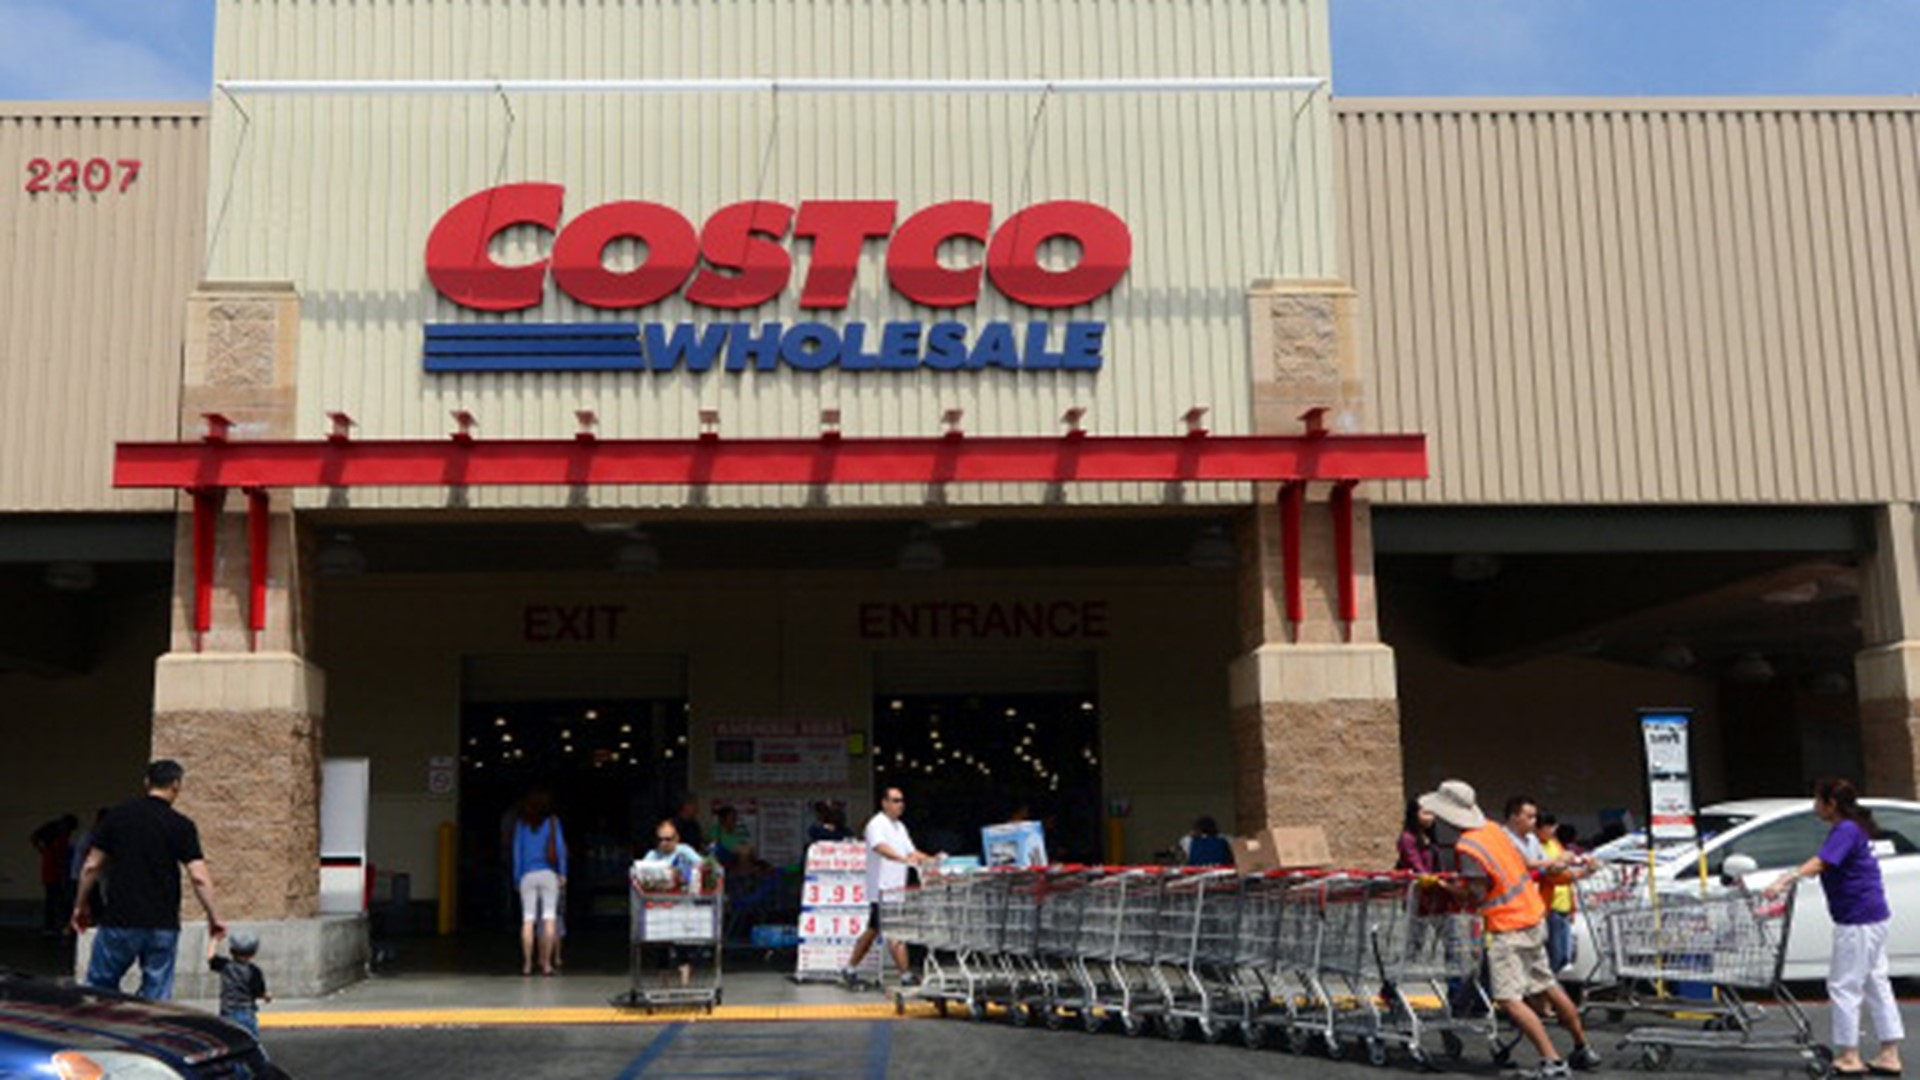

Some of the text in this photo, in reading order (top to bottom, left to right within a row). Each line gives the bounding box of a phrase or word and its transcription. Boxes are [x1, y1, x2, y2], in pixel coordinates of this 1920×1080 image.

[26, 157, 142, 193] 2207
[425, 181, 1132, 311] COSTCO
[642, 321, 1106, 373] WHOLESALE
[522, 603, 629, 642] EXIT
[858, 601, 1110, 639] ENTRANCE
[808, 884, 865, 904] 3.95
[804, 916, 861, 936] 4.15
